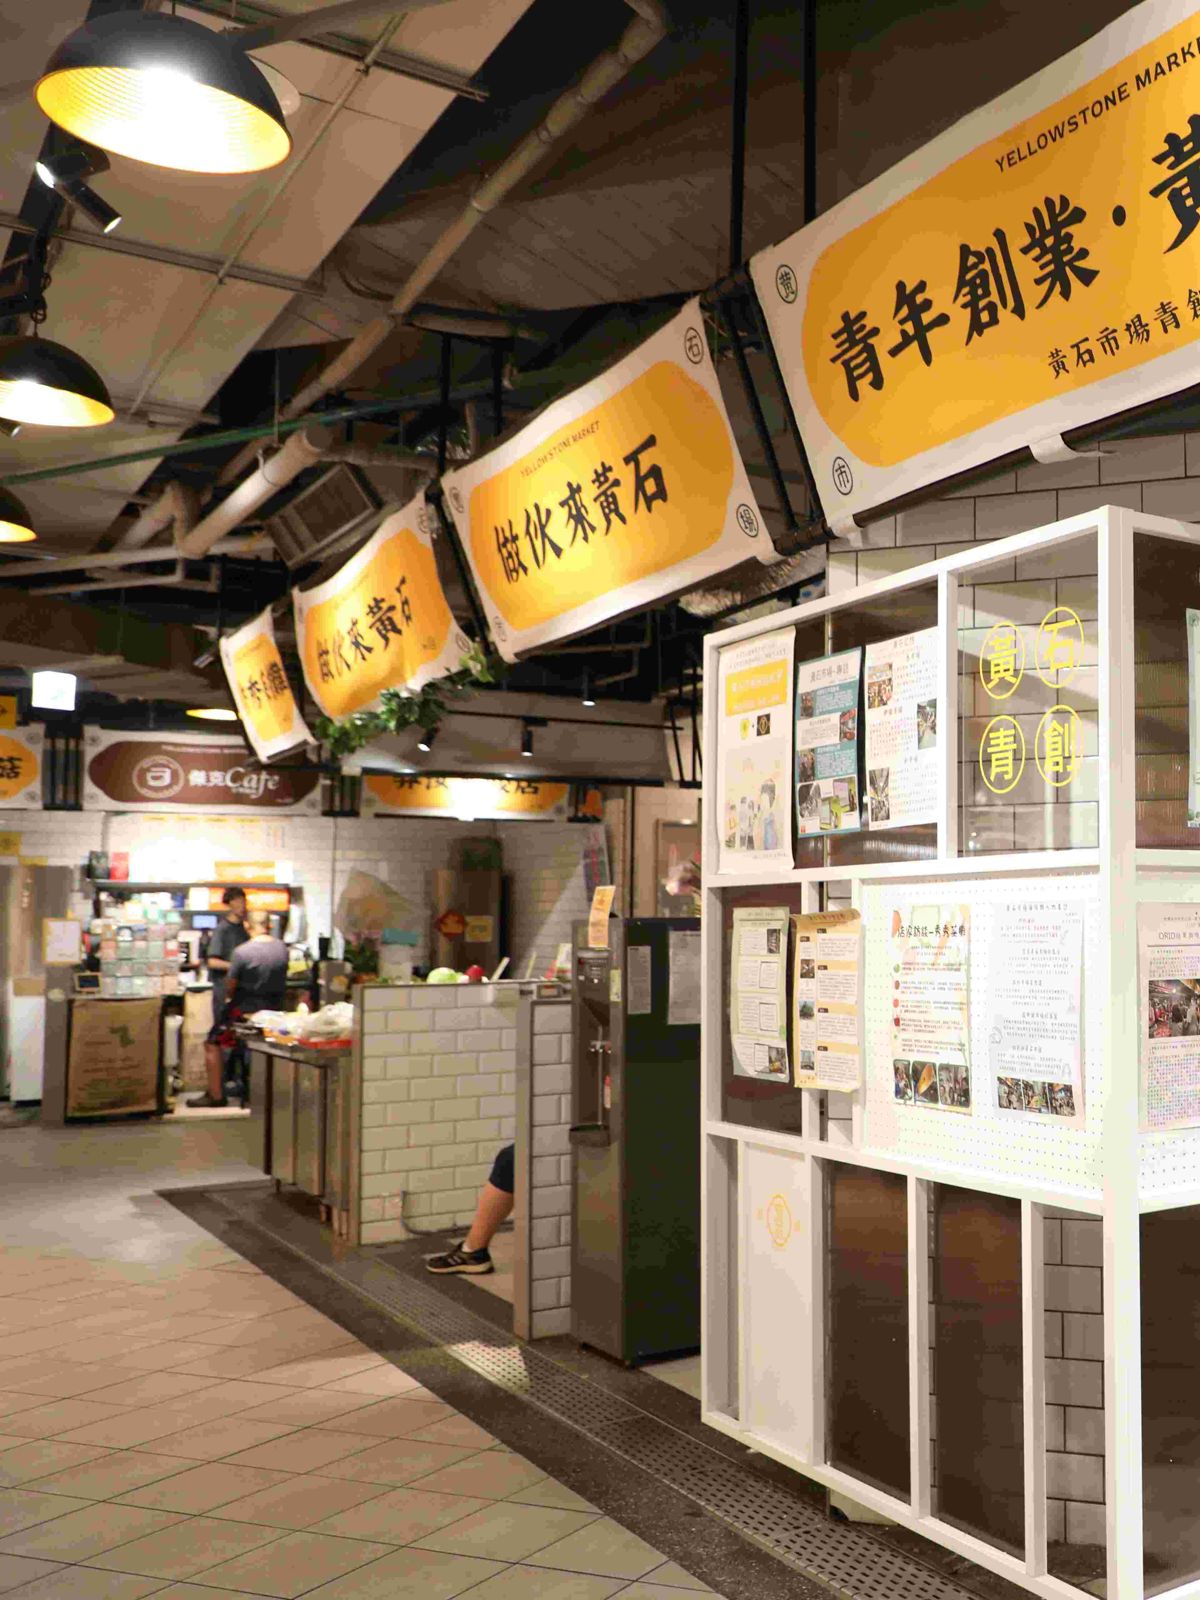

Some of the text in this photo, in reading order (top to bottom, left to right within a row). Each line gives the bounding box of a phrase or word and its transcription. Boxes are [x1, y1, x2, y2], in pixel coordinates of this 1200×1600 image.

[994, 81, 1132, 174] YELLOWSTONE
[686, 331, 702, 361] 石
[834, 461, 852, 491] 市
[494, 434, 668, 585] 做伙來黃石
